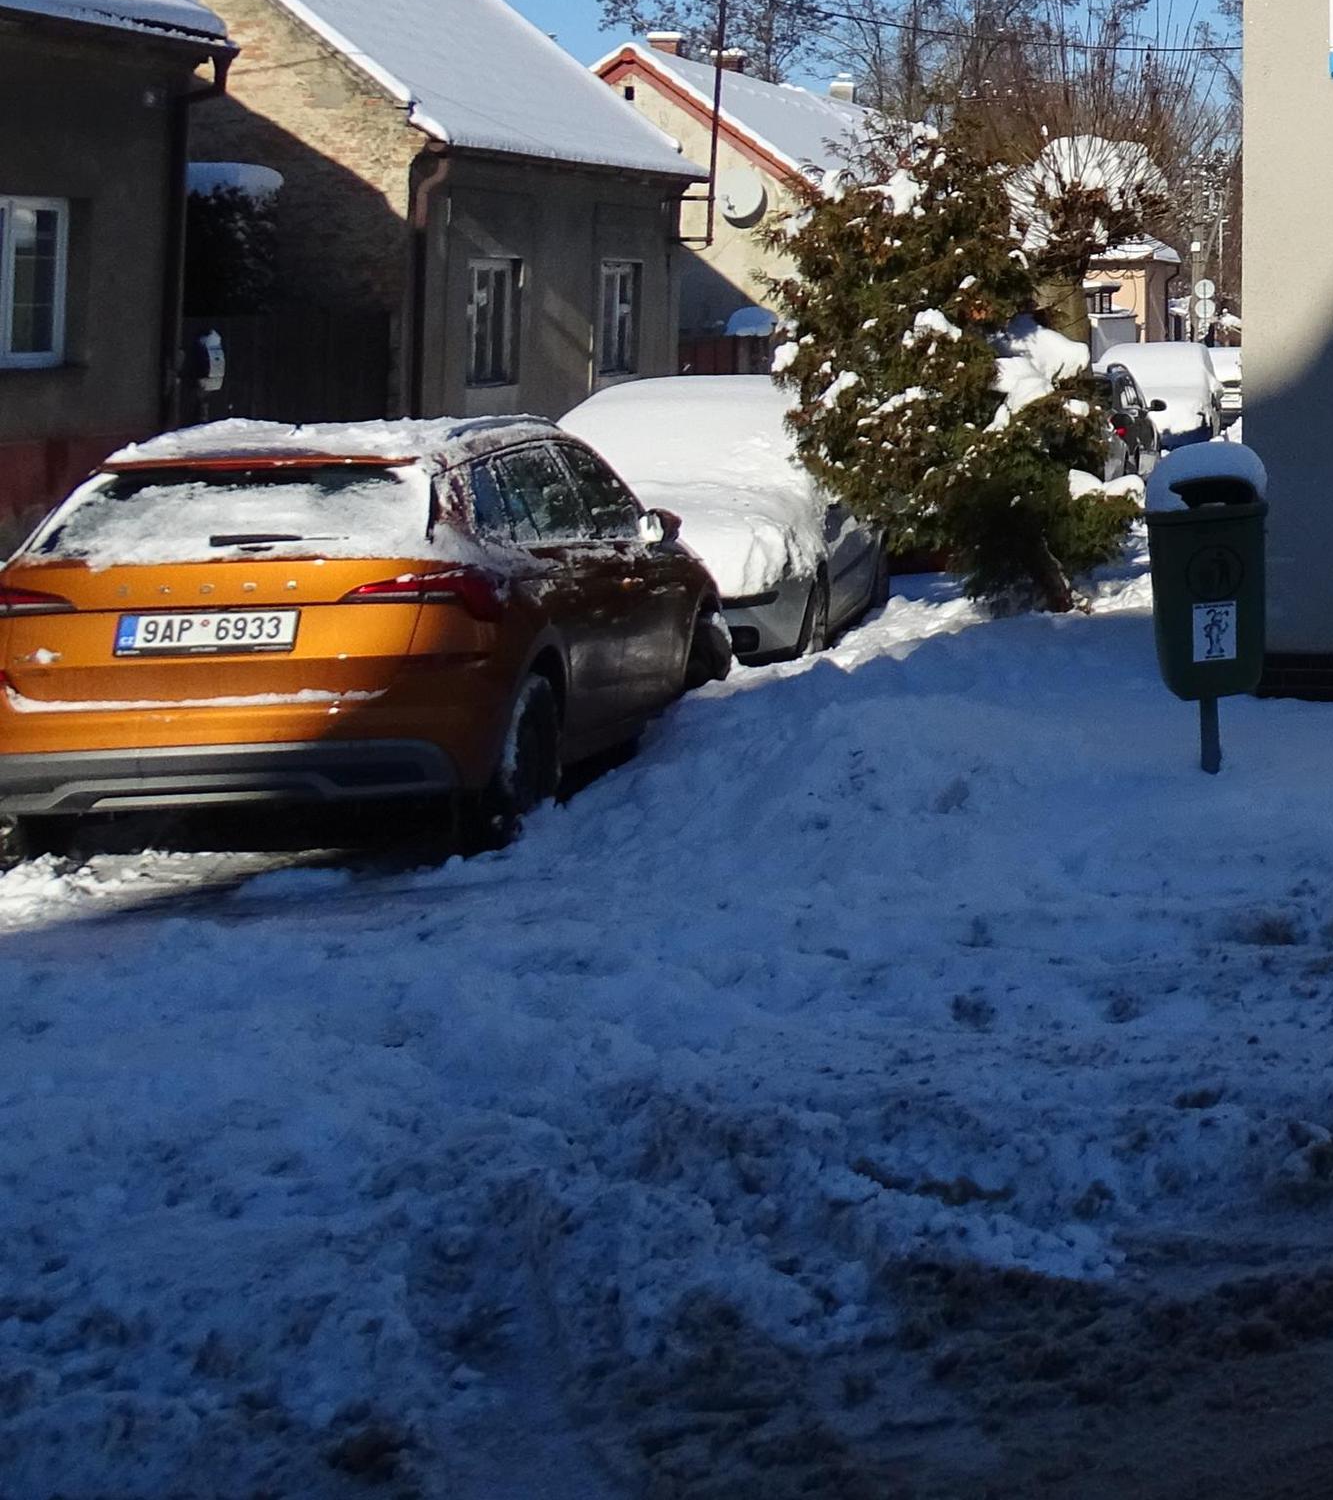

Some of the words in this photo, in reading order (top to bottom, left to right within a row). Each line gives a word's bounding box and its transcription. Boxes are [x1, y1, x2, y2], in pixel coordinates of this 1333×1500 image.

[143, 619, 194, 643] 9AP
[215, 615, 282, 641] 6933
[119, 636, 135, 644] CZ
